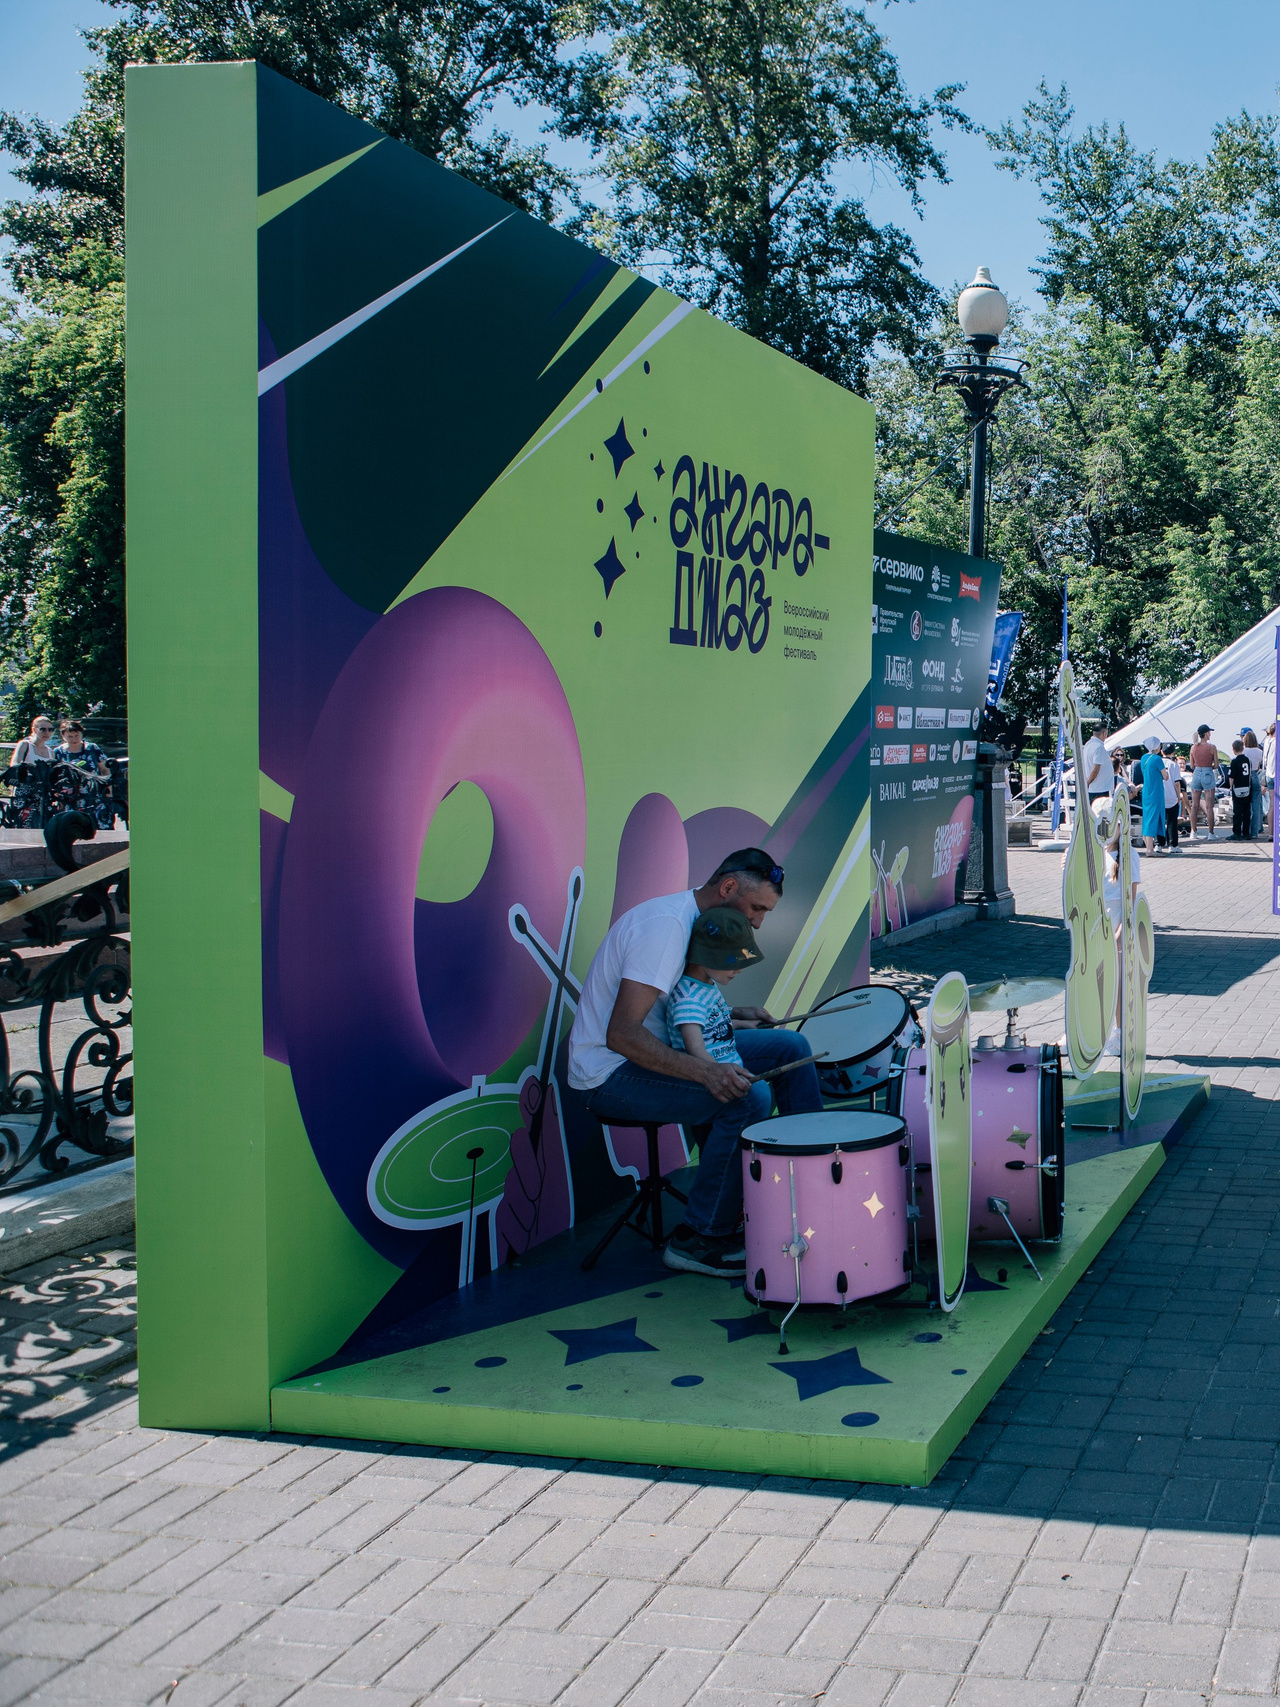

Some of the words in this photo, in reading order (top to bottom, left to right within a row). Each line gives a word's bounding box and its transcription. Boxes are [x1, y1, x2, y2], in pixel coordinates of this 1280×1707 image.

[880, 558, 924, 582] сервико
[783, 600, 830, 622] Всероссийский
[783, 624, 824, 642] молодёжный
[783, 644, 818, 662] фестиваль
[922, 660, 945, 682] ФОНД
[1242, 762, 1250, 776] 3
[880, 782, 906, 801] BAIKAL
